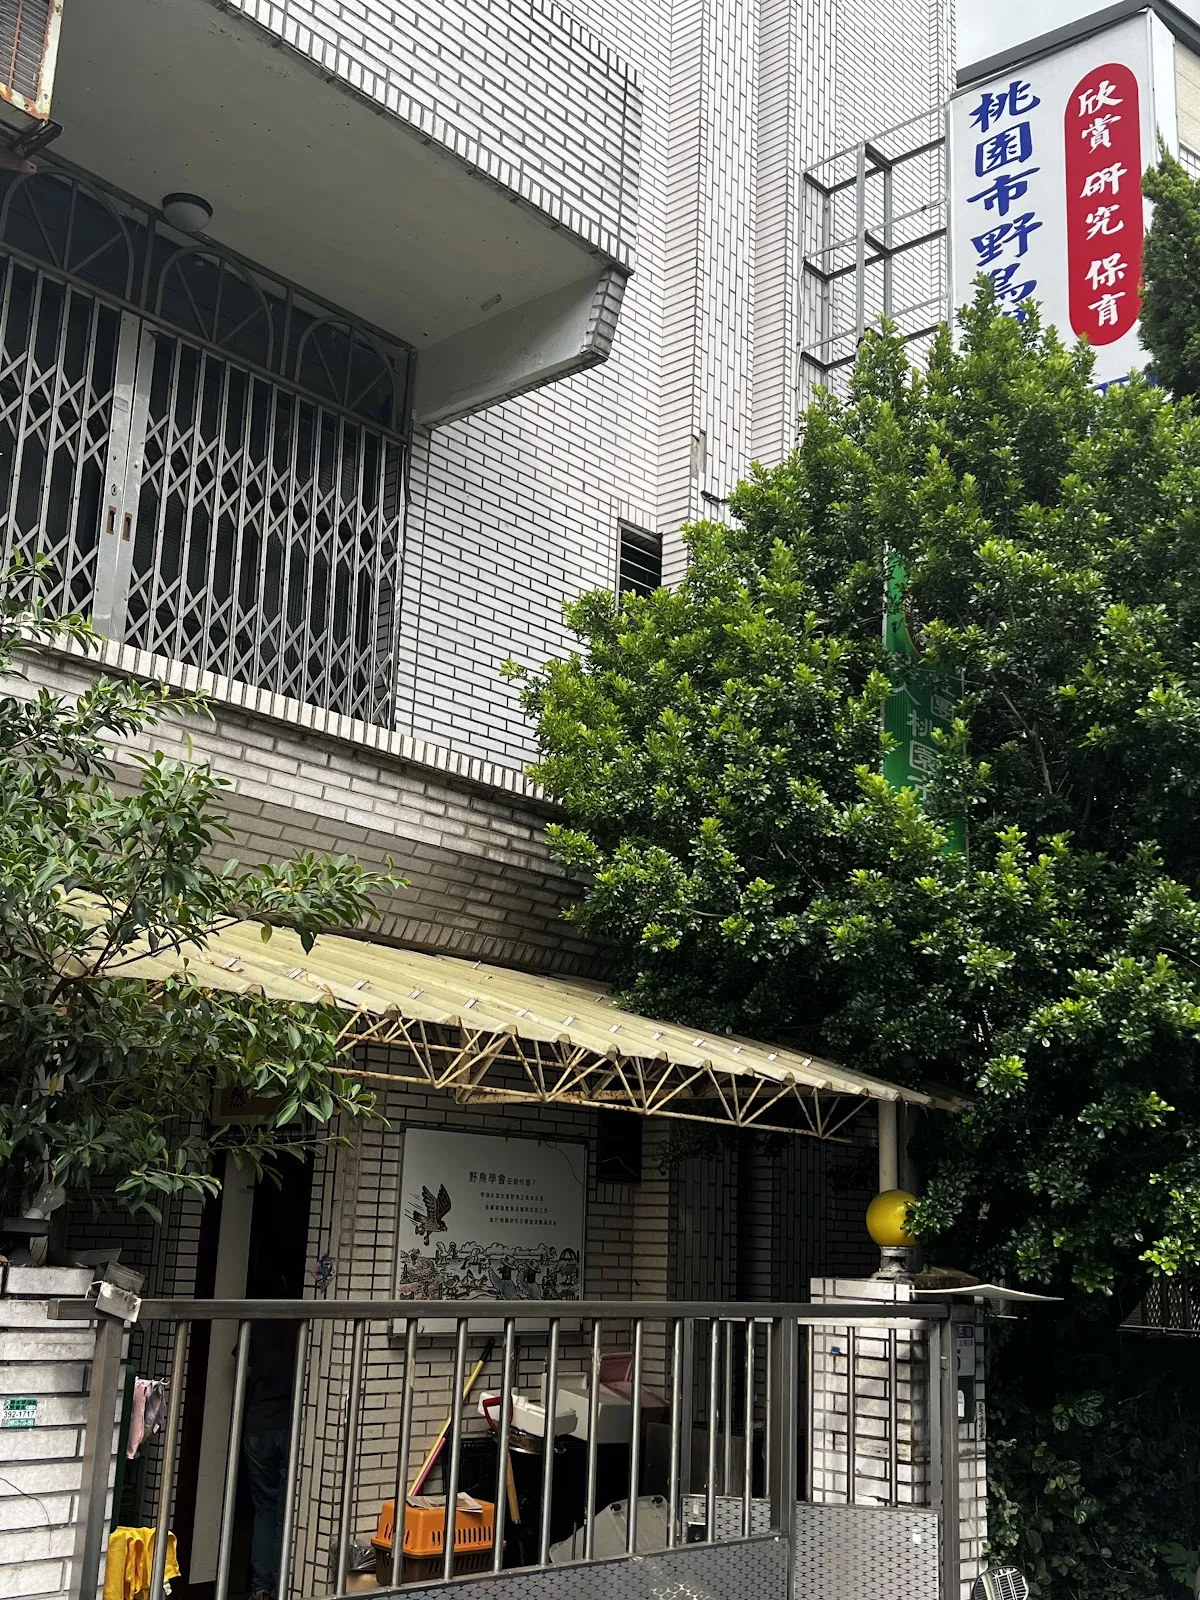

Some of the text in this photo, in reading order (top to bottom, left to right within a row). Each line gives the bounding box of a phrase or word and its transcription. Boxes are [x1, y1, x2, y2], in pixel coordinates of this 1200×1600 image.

[966, 80, 1043, 322] 桃園市野鳥
[1078, 80, 1127, 326] 欣賞 研究 保育
[3, 1410, 35, 1418] 392-1717
